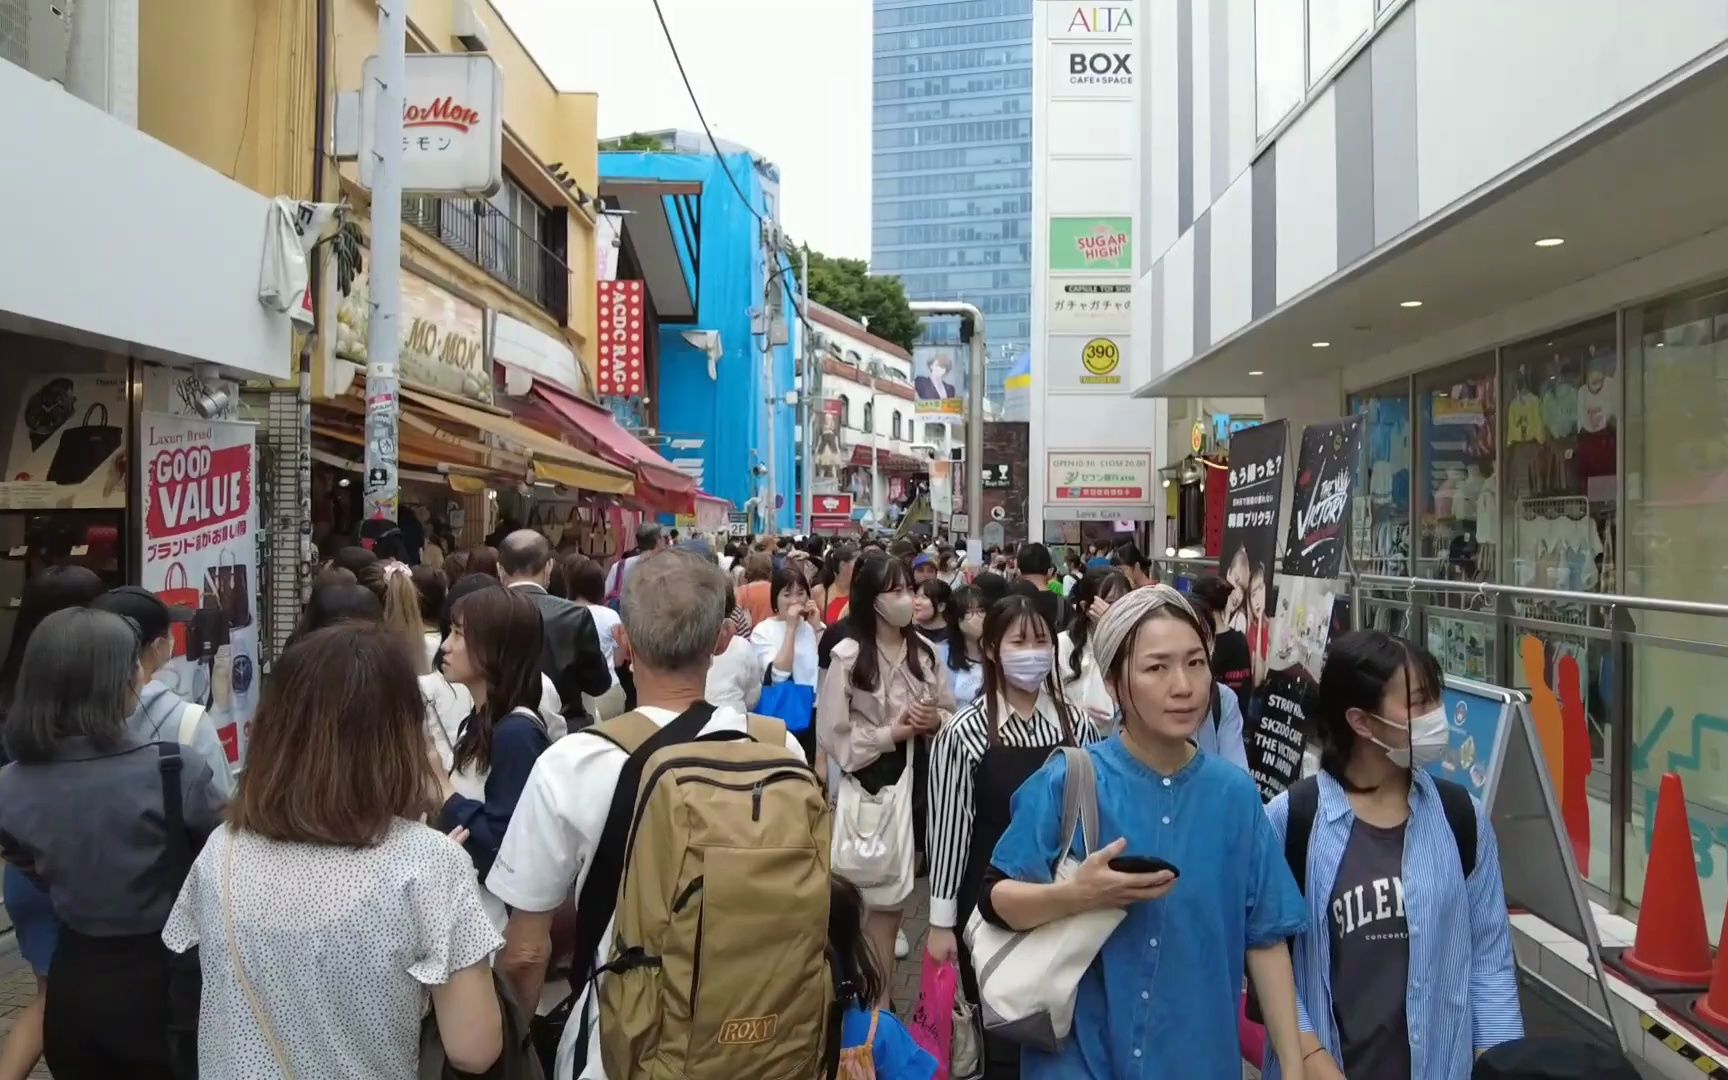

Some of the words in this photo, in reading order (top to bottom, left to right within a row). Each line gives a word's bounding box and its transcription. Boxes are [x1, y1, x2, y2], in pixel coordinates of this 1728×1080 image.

[1068, 7, 1132, 32] ALTA
[1070, 53, 1132, 75] BOX
[1077, 233, 1126, 249] SUGAR
[1085, 245, 1121, 260] HIGH!
[612, 290, 627, 341] ACDC
[1086, 345, 1115, 358] 390
[157, 448, 211, 484] GOOD
[158, 471, 241, 528] VALUE
[731, 524, 745, 536] 2F
[1262, 751, 1275, 766] IN
[725, 1019, 773, 1041] ROXY
